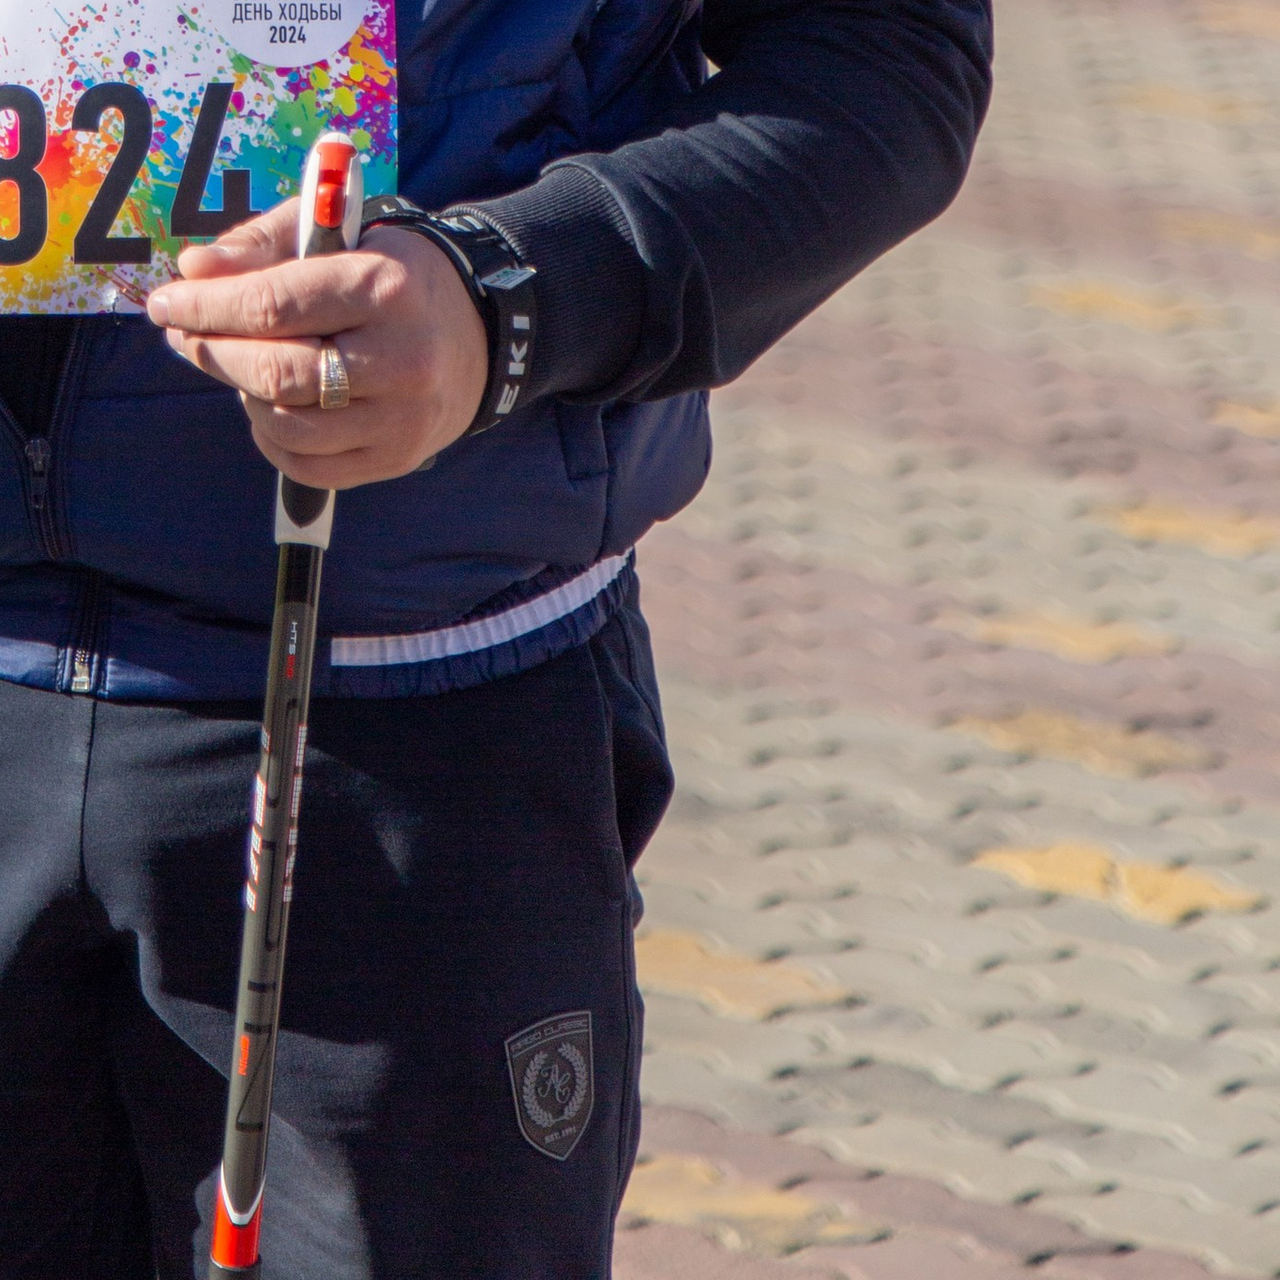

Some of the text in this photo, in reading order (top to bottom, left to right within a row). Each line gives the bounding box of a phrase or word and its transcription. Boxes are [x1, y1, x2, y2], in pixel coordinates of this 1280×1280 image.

[232, 3, 342, 23] ДЕНЬ ХОДЬБЫ
[269, 25, 307, 44] 2024
